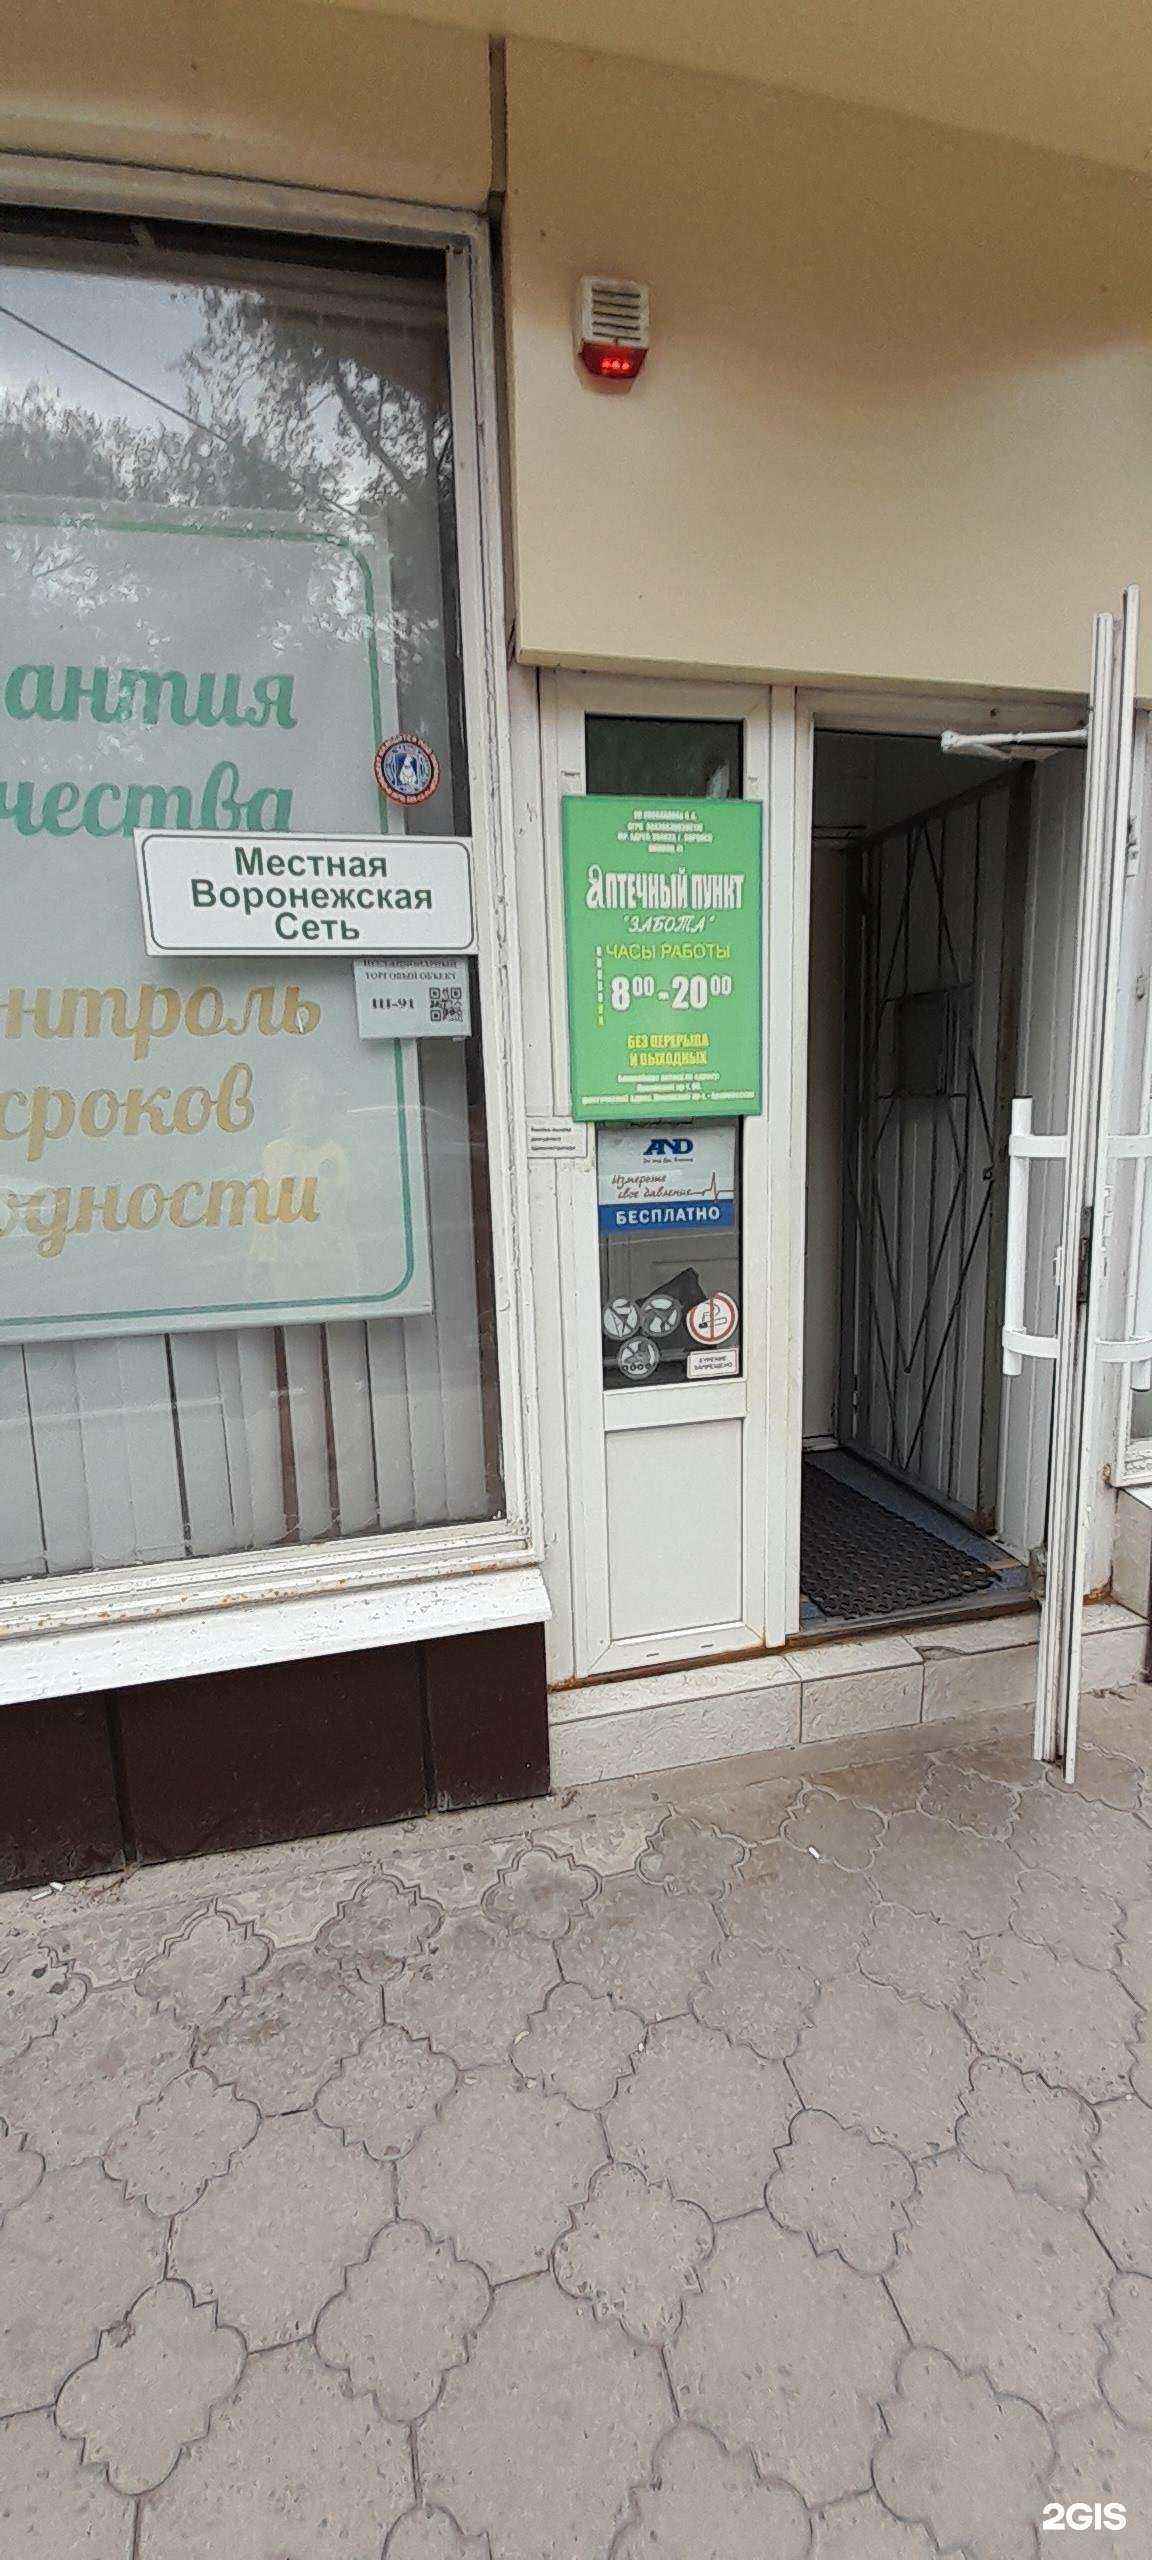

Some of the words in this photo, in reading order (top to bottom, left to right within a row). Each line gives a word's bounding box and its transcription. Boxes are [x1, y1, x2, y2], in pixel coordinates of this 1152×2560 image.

[4, 663, 299, 730] антия
[0, 760, 294, 837] чества
[235, 846, 388, 878] Местная
[190, 879, 433, 915] Воронежская
[691, 873, 746, 910] ПУНКТ
[275, 912, 361, 941] Сеть
[606, 943, 656, 960] ЧАСЫ
[661, 943, 732, 960] РАБОТЫ
[2, 983, 322, 1061] нтроль
[627, 1033, 648, 1049] БЕЗ
[649, 1032, 710, 1049] ПЕРЕРЫВА
[629, 1051, 637, 1067] И
[639, 1050, 707, 1067] ВЫХОДНЫХ
[0, 1063, 255, 1161] сроков
[642, 1138, 694, 1155] AND
[616, 1206, 720, 1225] БЕСПЛАТНО
